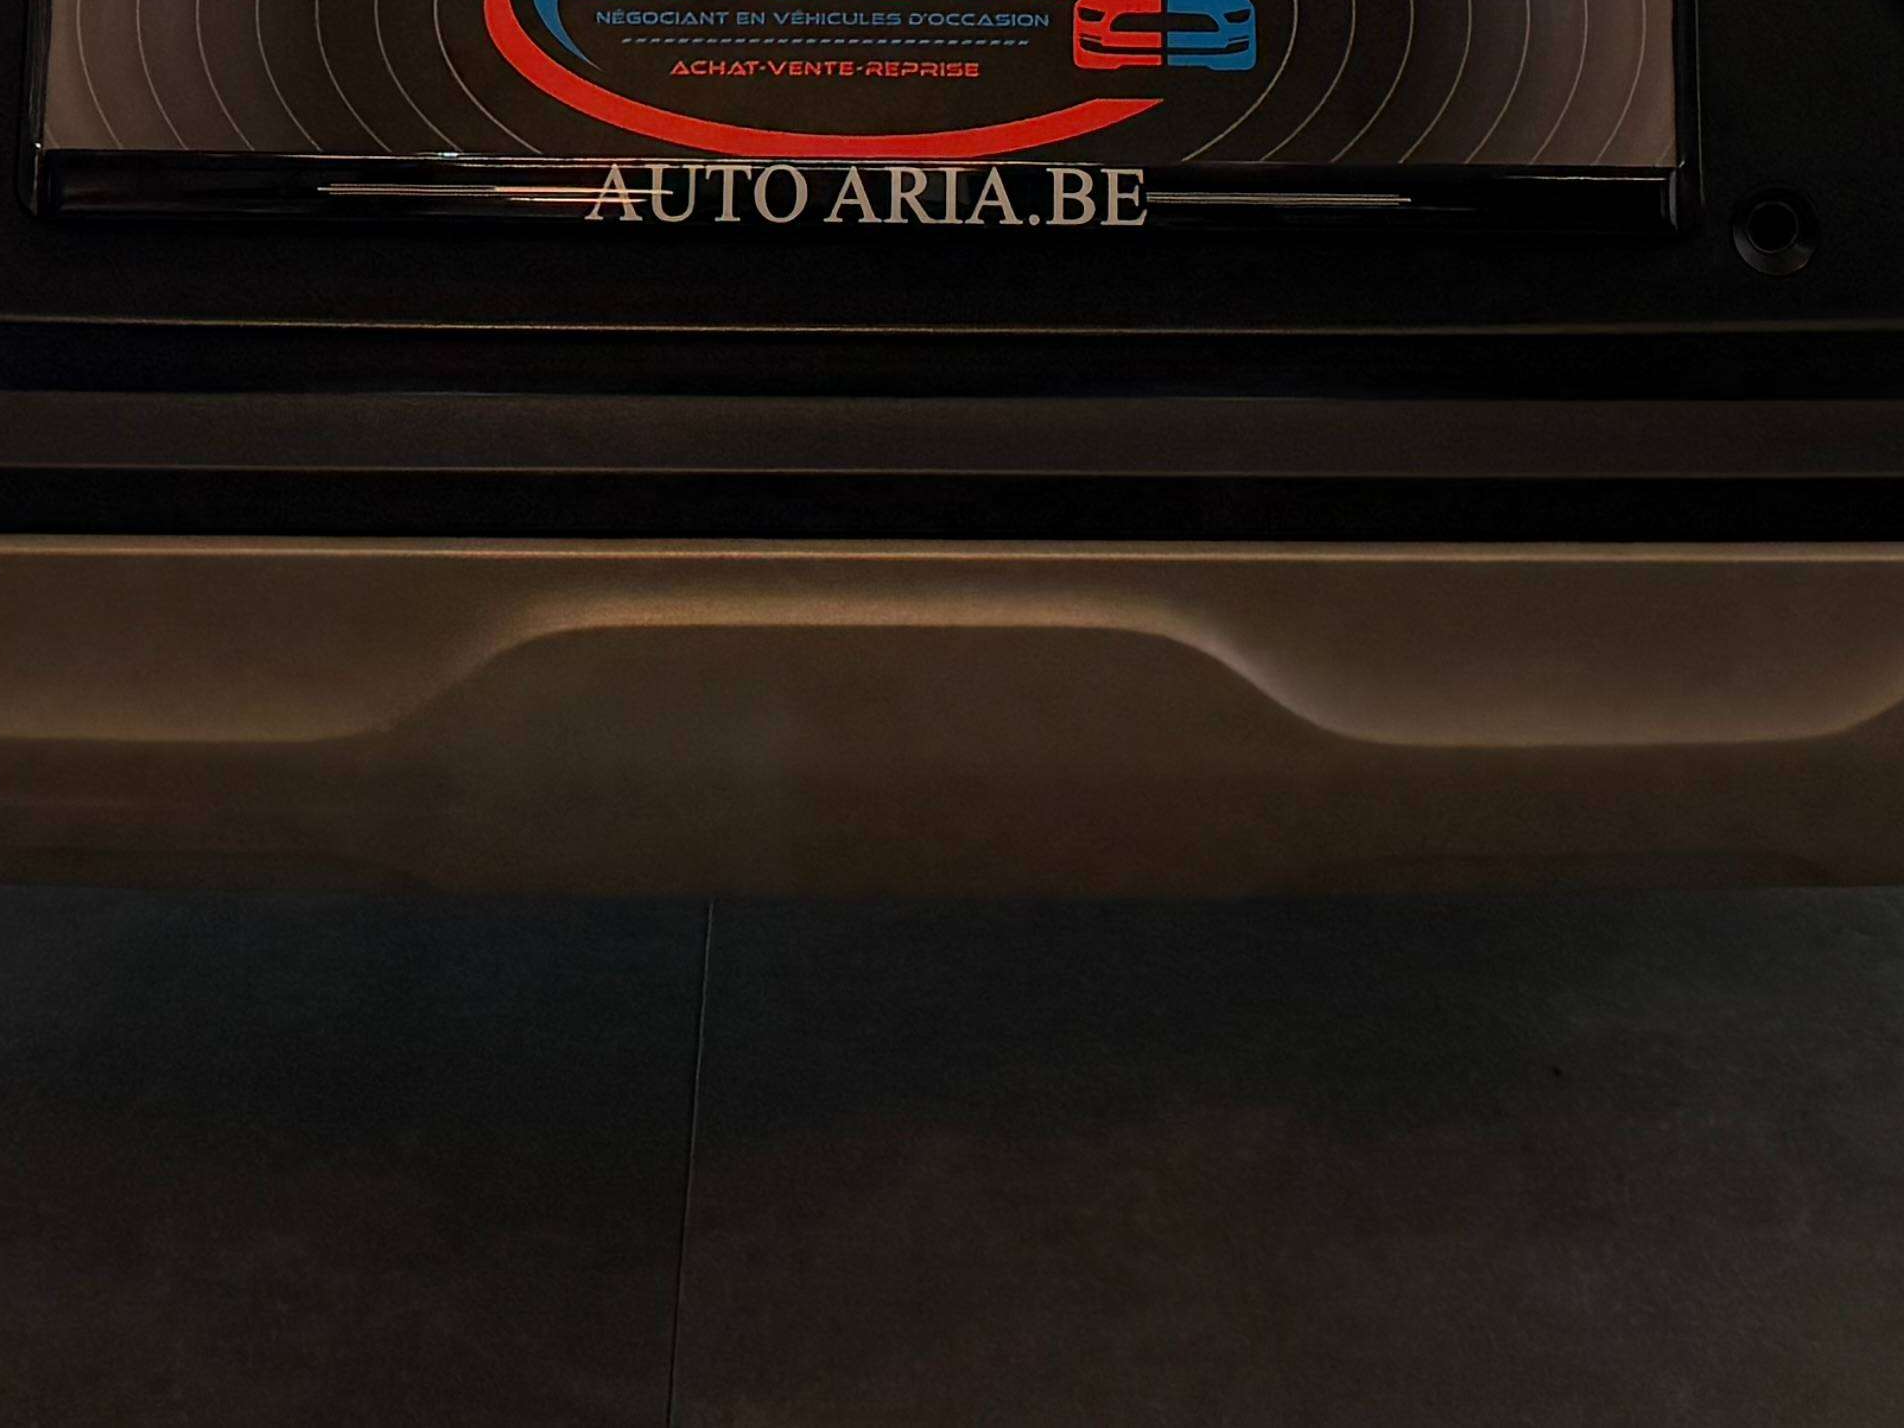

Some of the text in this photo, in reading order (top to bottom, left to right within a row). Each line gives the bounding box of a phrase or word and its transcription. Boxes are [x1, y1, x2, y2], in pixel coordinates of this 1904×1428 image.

[596, 9, 1049, 28] NÉGOCIANT EN VÉHICULES D'OCCASION
[669, 59, 980, 77] ACHAT-VENTE-REPRISE
[584, 164, 1148, 226] AUTO ARIA.BE
